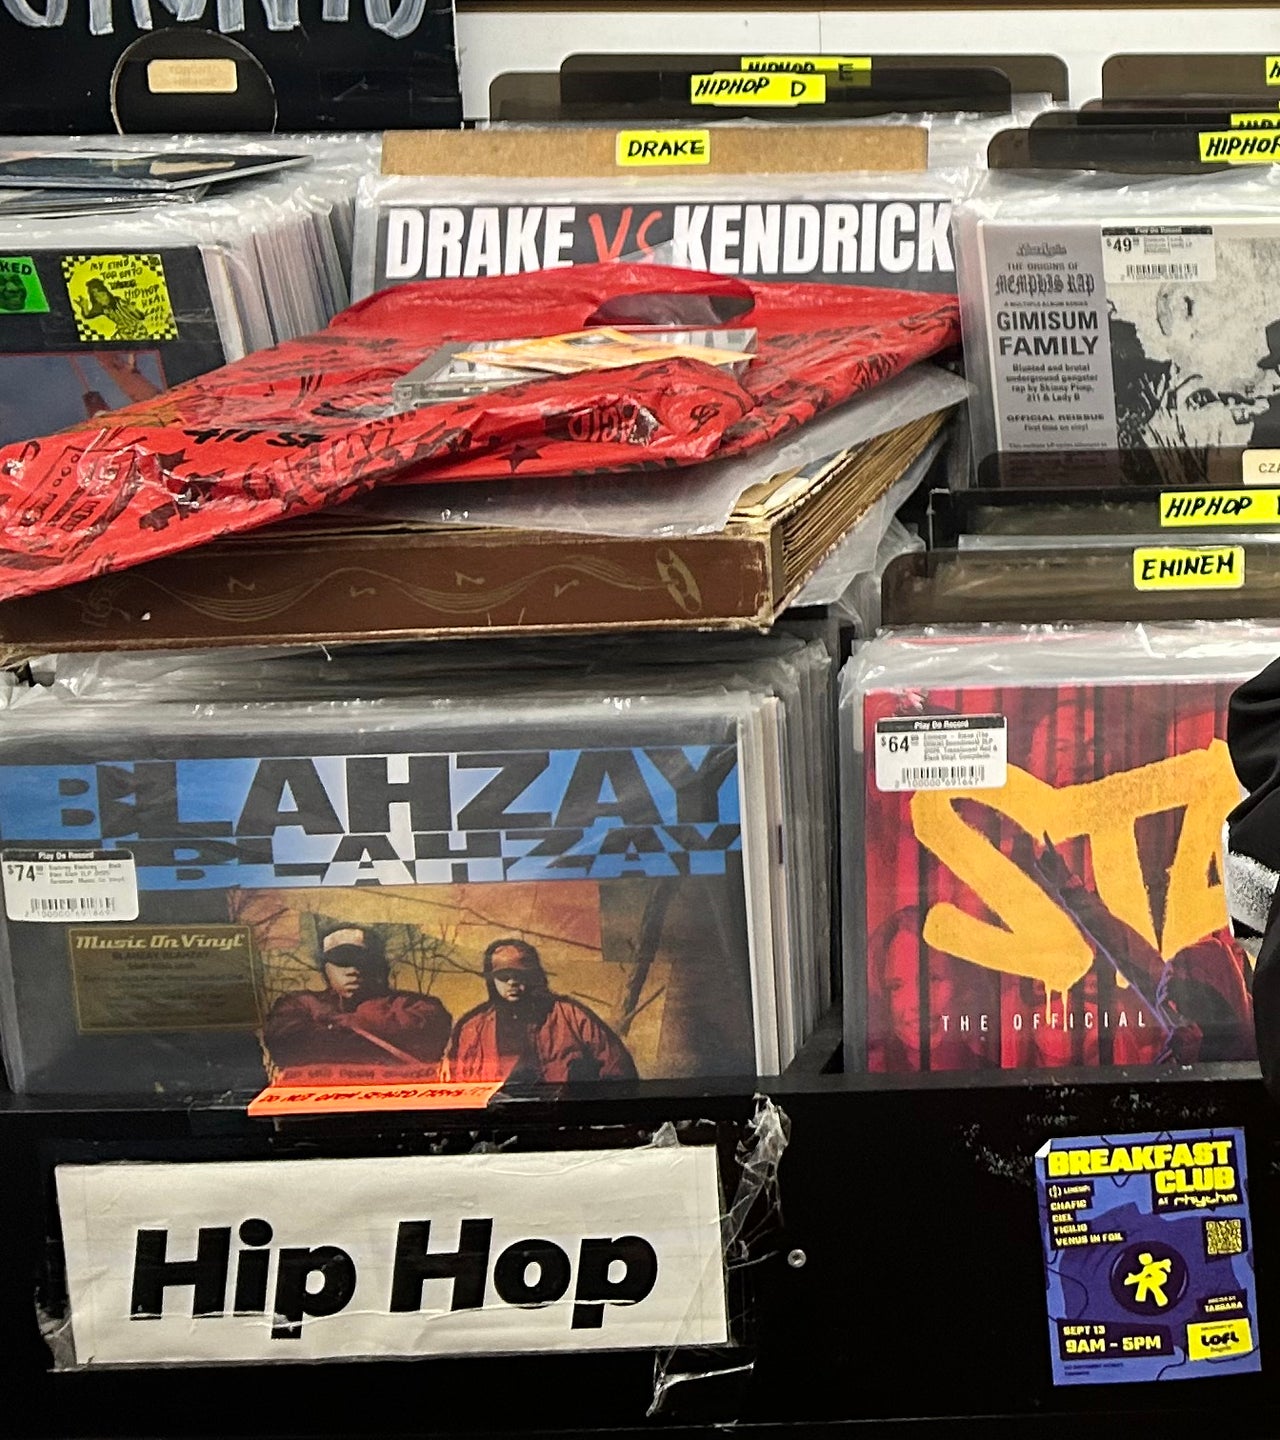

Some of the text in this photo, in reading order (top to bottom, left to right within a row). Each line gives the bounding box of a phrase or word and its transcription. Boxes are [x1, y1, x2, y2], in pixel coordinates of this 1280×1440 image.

[791, 79, 806, 98] D
[628, 138, 705, 158] DRAKE
[385, 202, 956, 277] DRAKE VS KENDRICK
[1106, 238, 1132, 252] $49
[1007, 261, 1078, 271] THE ORIGINS OF
[995, 274, 1095, 297] MEMPHIS RAP
[996, 311, 1099, 331] GIMISUM
[999, 335, 1099, 356] FAMILY
[1047, 364, 1062, 372] and
[1064, 363, 1090, 372] brutal
[1006, 373, 1098, 383] underground gangster
[1011, 385, 1026, 393] rap
[1028, 384, 1037, 393] by
[1039, 383, 1068, 393] Skinny
[1051, 393, 1072, 403] Lady
[1141, 551, 1234, 580] EMINEM
[914, 720, 969, 730] Play Record
[881, 735, 910, 752] $64
[38, 851, 94, 860] Play Record
[7, 864, 36, 882] $74
[76, 934, 243, 951] Music On Vinyl
[941, 1012, 1146, 1032] THE OFFICIAL
[1048, 1141, 1232, 1177] BREAKFAST
[1154, 1166, 1236, 1194] CLUB
[1050, 1200, 1087, 1211] CHAFIC
[1174, 1193, 1238, 1208] rhythm
[1055, 1235, 1088, 1247] VENUS
[1090, 1234, 1101, 1243] IN
[129, 1217, 659, 1340] Hip Hop
[1063, 1325, 1106, 1335] SEPT 13
[1065, 1335, 1161, 1353] 9AM 5PM
